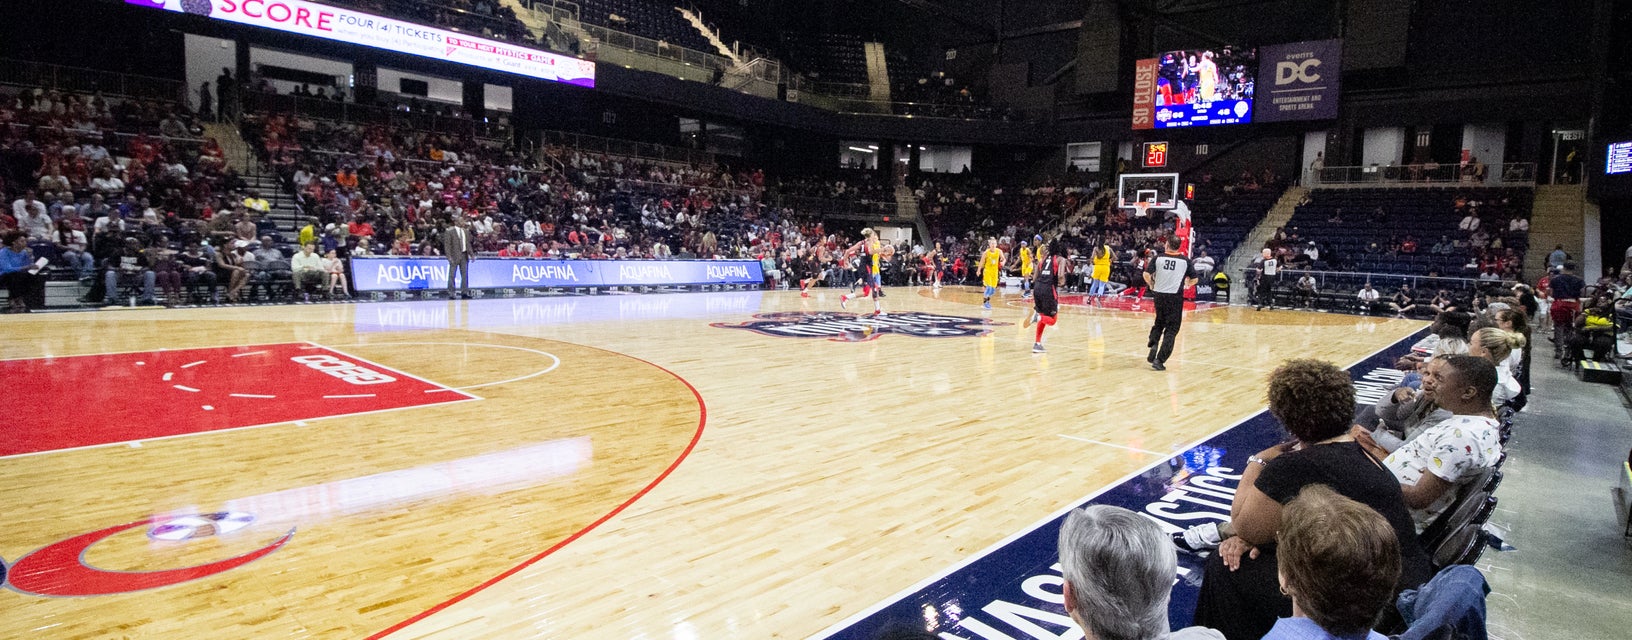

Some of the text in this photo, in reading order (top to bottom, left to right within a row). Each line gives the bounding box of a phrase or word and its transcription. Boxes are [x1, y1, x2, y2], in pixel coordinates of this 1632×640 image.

[219, 0, 335, 32] SCORE
[339, 14, 442, 43] FOUR (4) TICKETS
[1286, 51, 1314, 60] events
[1275, 58, 1322, 86] DC
[1133, 64, 1153, 124] SO CLOSE
[1279, 103, 1298, 111] SPORTS
[1148, 151, 1163, 164] 20
[1195, 144, 1208, 155] 110
[512, 264, 579, 282] AQUAFINA
[619, 264, 673, 281] AQUAFINA
[706, 264, 752, 279] AQUAFINA
[1163, 259, 1177, 271] 39
